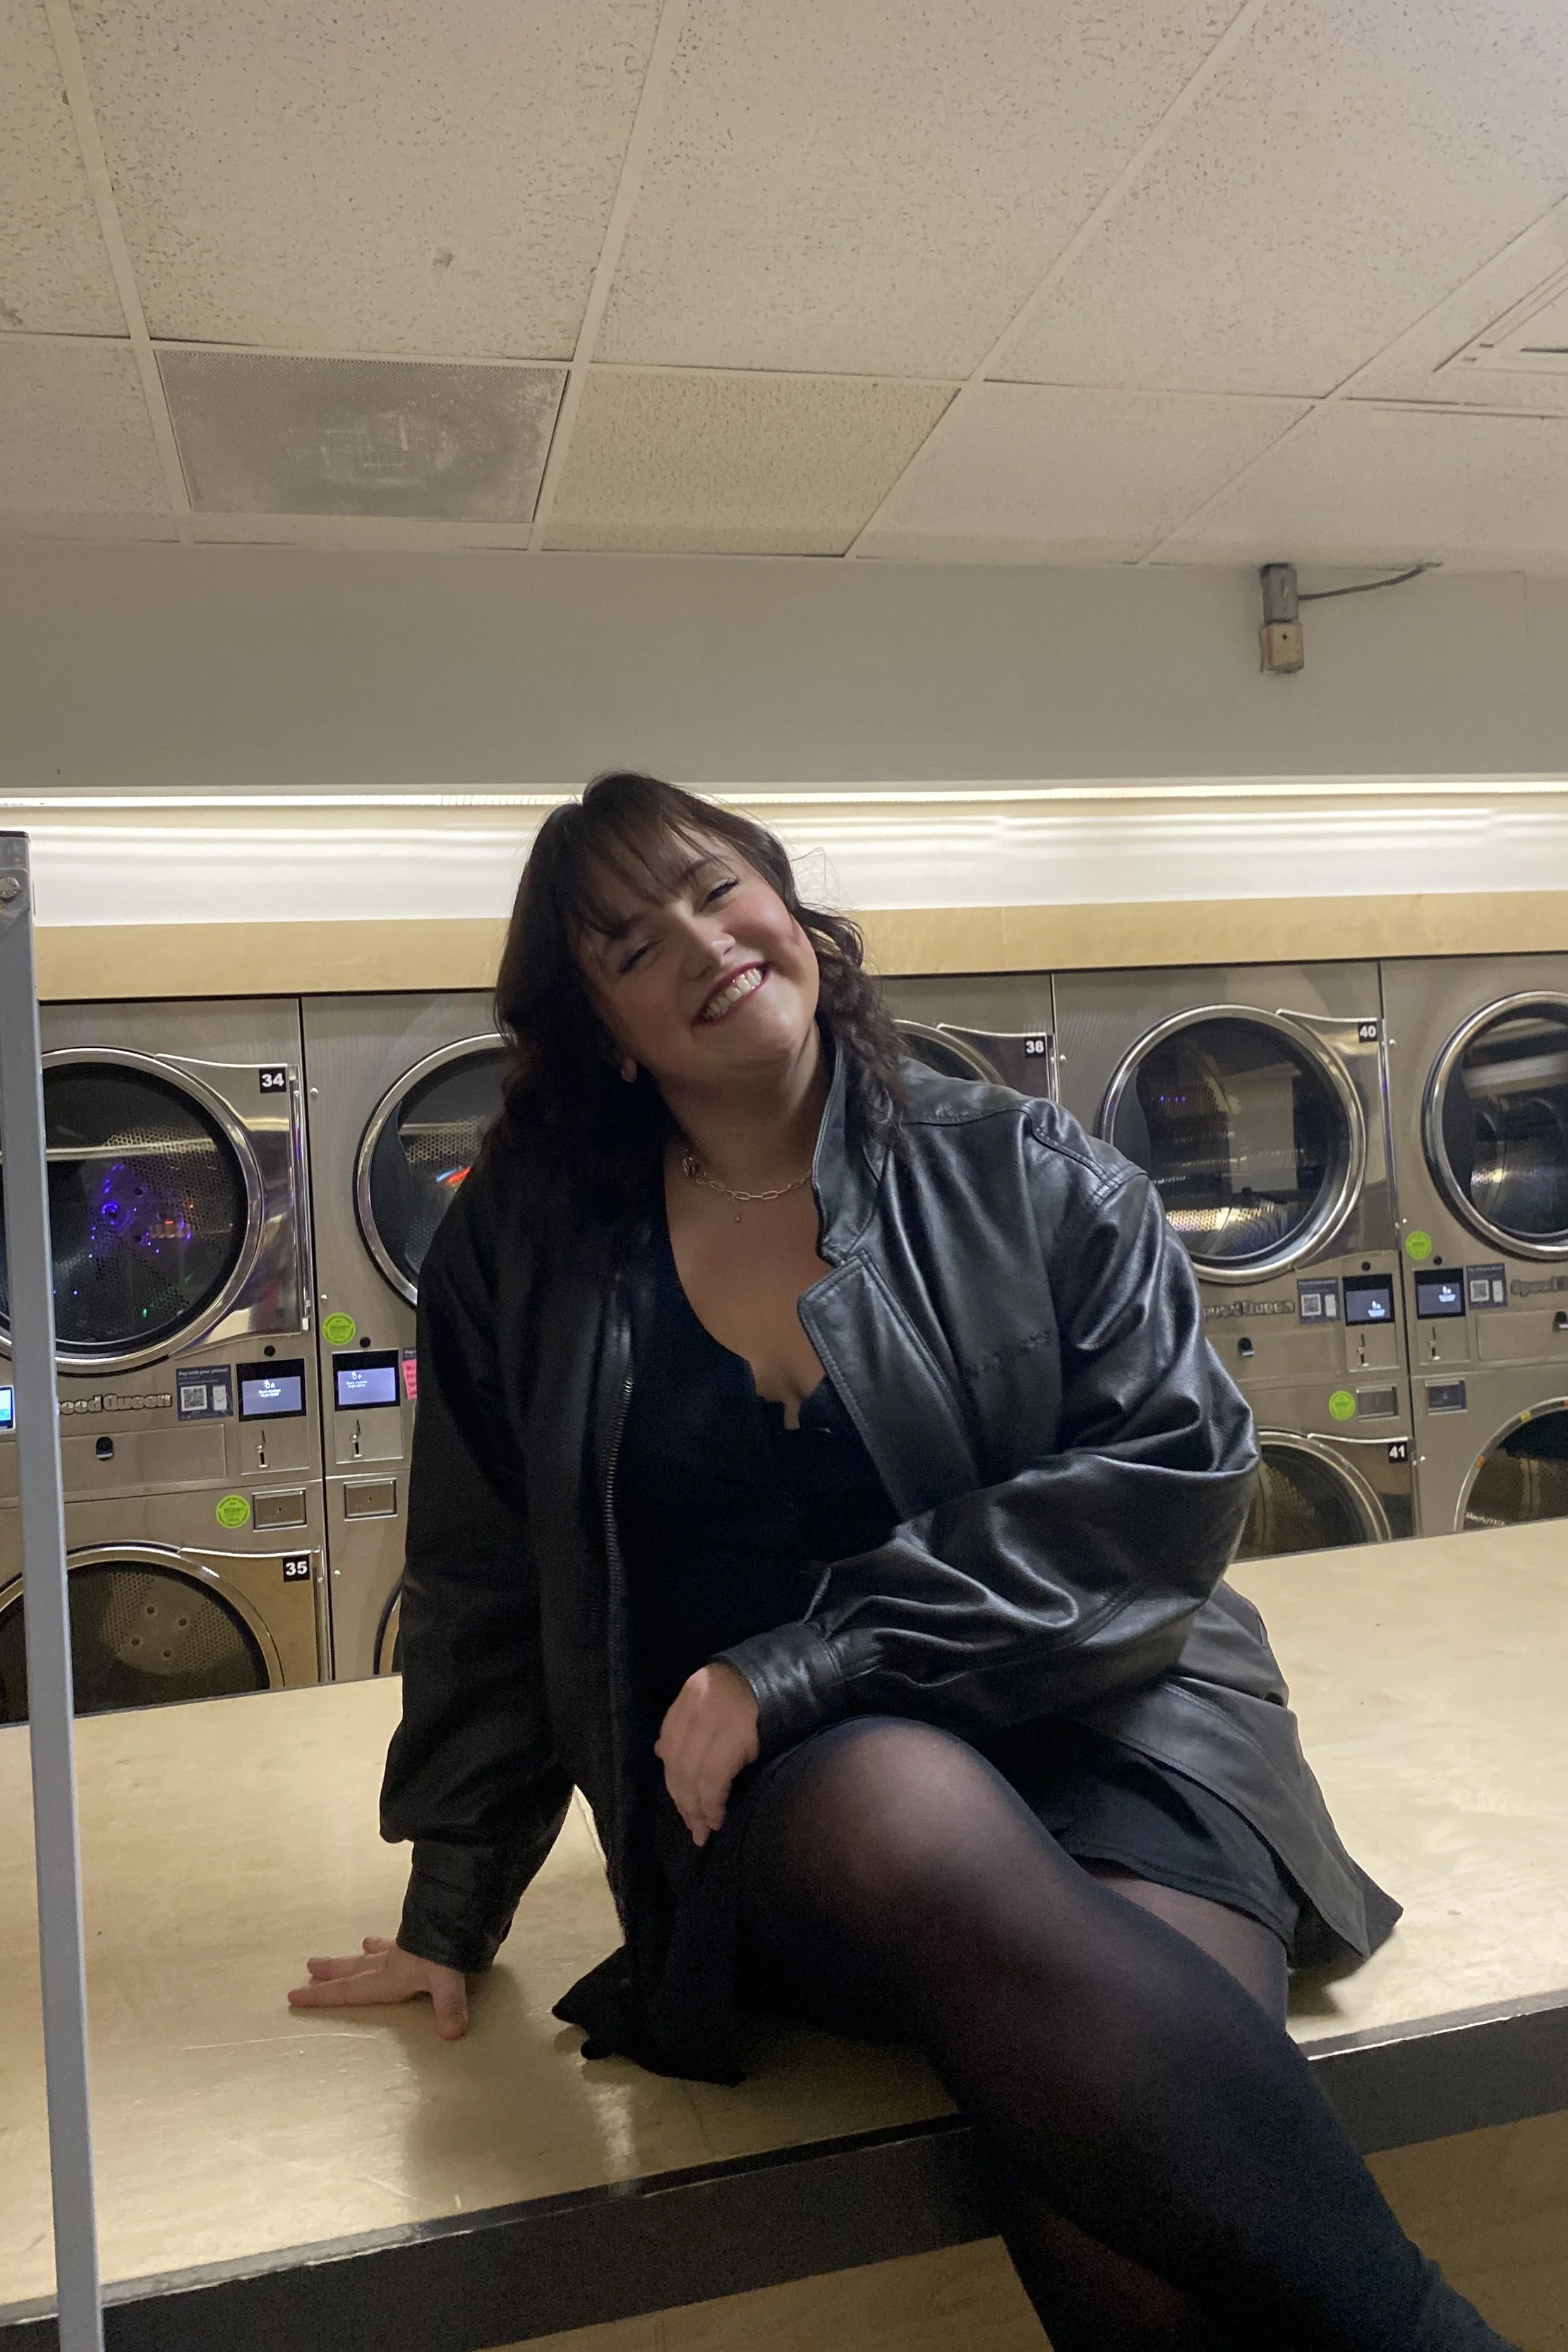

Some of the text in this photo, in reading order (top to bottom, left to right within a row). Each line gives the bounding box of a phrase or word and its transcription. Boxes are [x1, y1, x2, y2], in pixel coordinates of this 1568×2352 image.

[1359, 1025, 1377, 1038] 40
[1025, 1040, 1044, 1054] 38
[262, 1073, 284, 1087] 34
[104, 1393, 172, 1412] Queen
[1389, 1445, 1405, 1459] 41
[285, 1560, 308, 1576] 35
